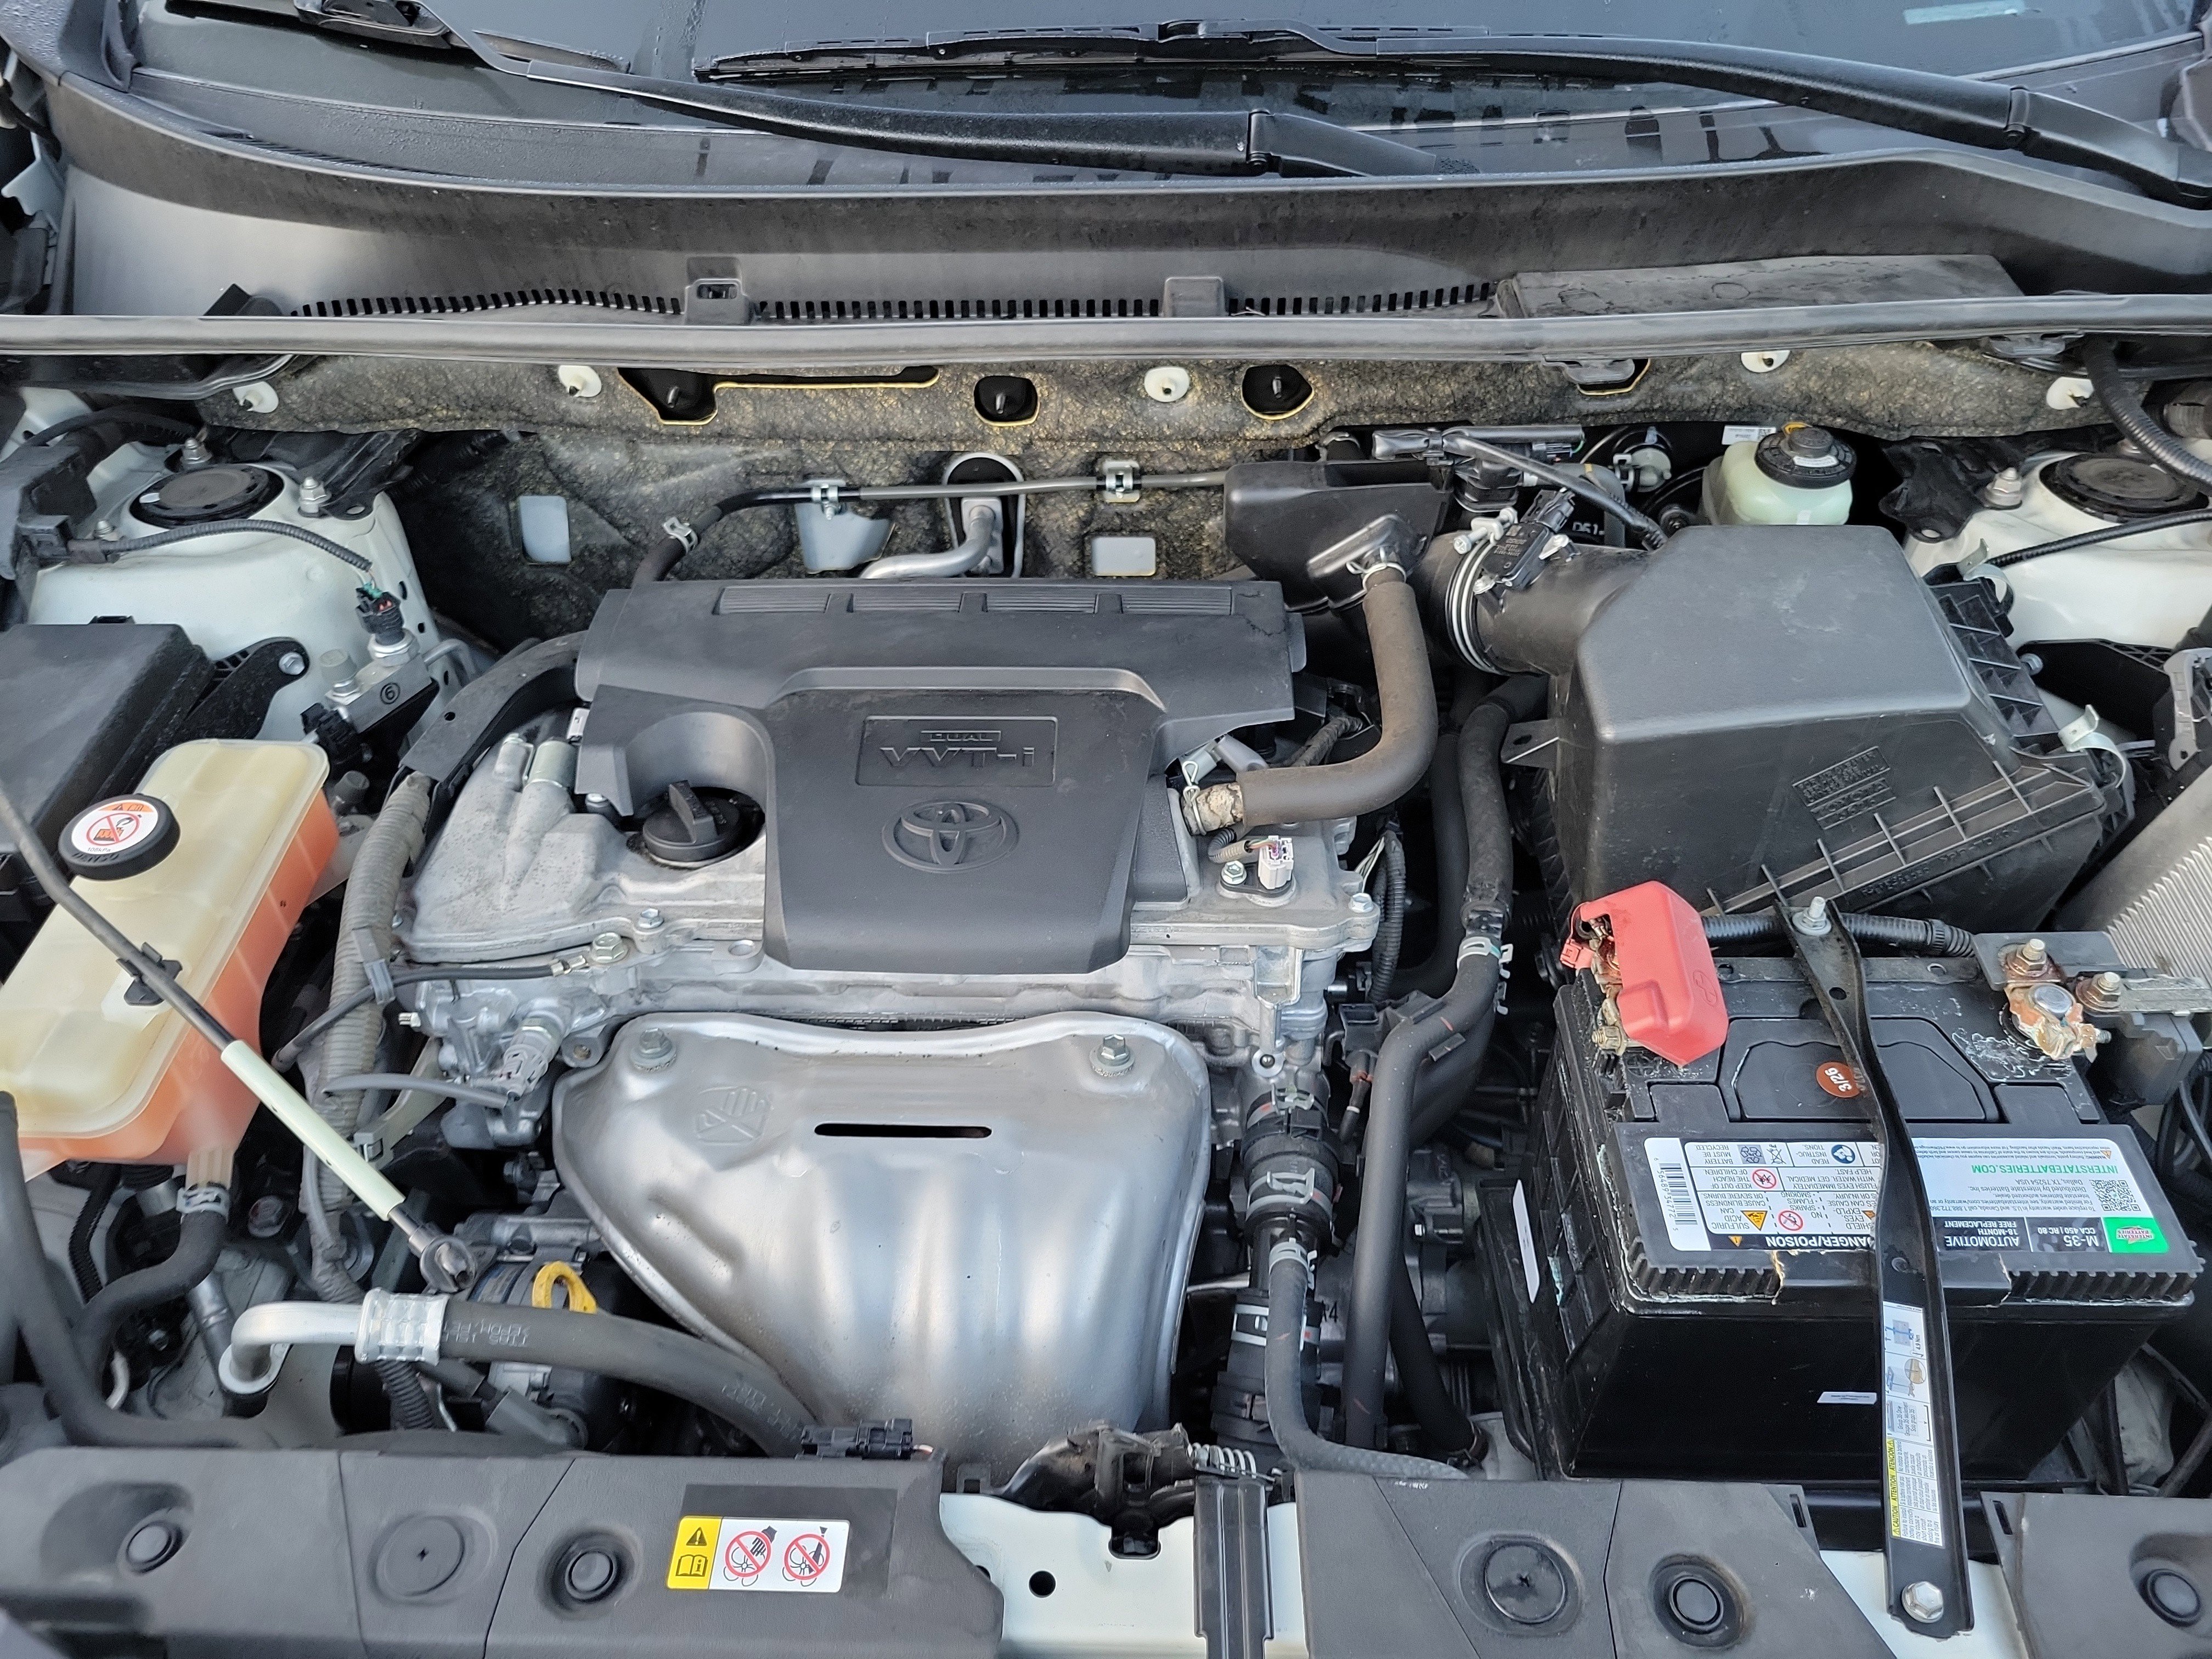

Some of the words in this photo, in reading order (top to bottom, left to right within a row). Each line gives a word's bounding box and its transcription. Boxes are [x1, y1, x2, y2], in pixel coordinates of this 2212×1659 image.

[929, 733, 994, 742] DUAL
[879, 747, 1036, 769] VVT-i
[1824, 1067, 1852, 1092] 3/26
[1972, 1165, 2118, 1173] INTERSTATEBATTERIES.COM
[1657, 1170, 1669, 1191] 56489
[1663, 1193, 1675, 1218] 34772
[1944, 1236, 2019, 1246] AUTOMOTIVE
[2063, 1235, 2099, 1246] M-35
